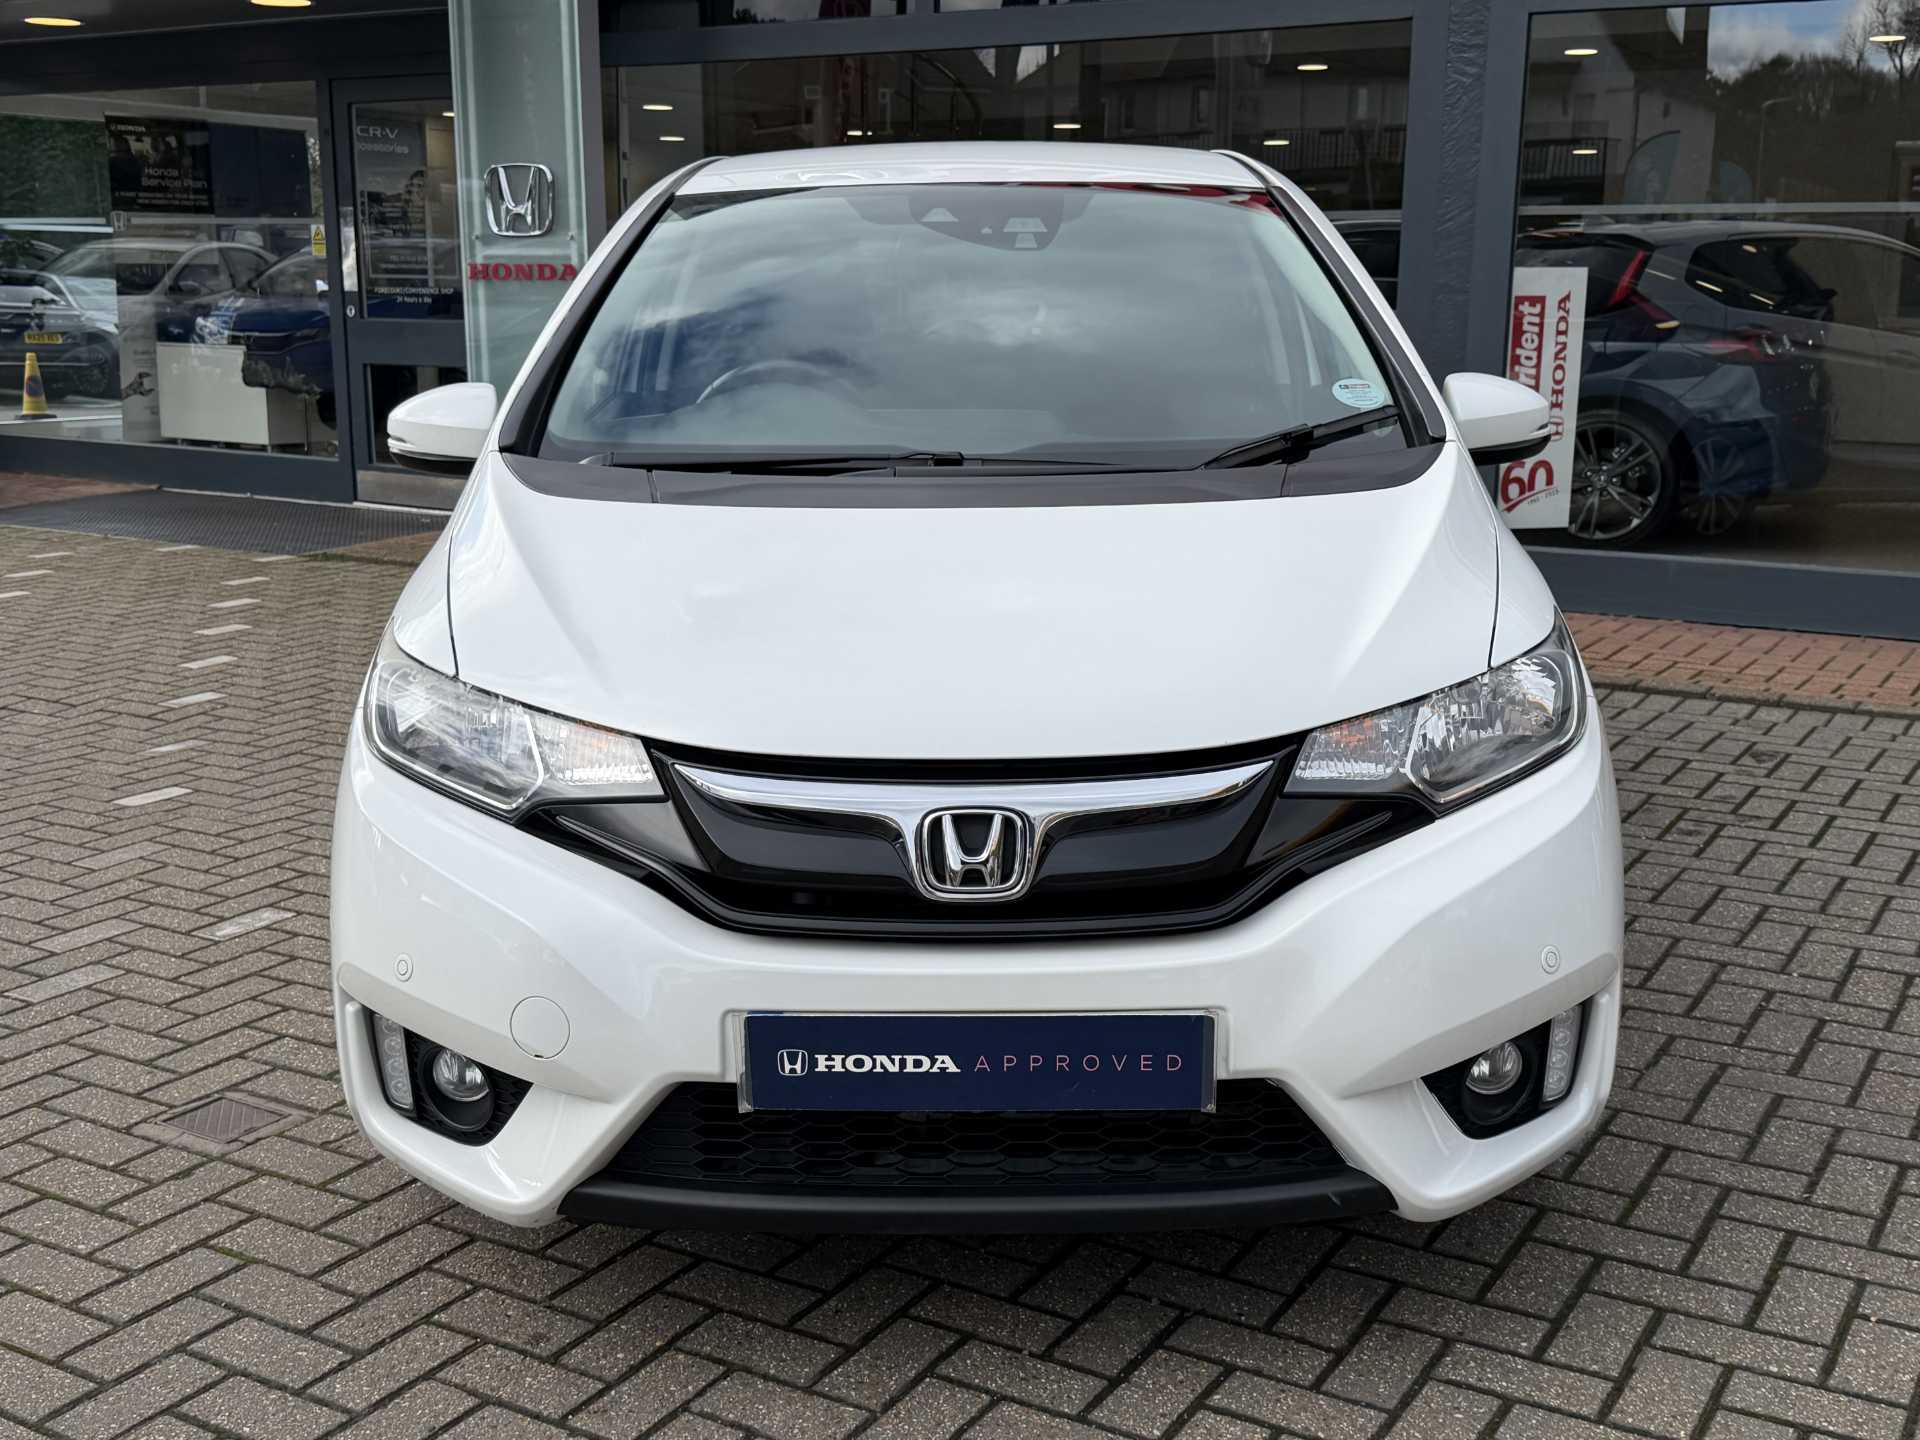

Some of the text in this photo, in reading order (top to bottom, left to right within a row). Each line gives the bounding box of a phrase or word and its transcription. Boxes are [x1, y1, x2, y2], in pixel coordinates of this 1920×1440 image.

[144, 167, 179, 177] Honda
[468, 262, 577, 281] HONDA
[1514, 300, 1542, 387] rident
[1550, 289, 1571, 410] HONDA
[814, 1054, 1182, 1073] HONDA APPROVED
